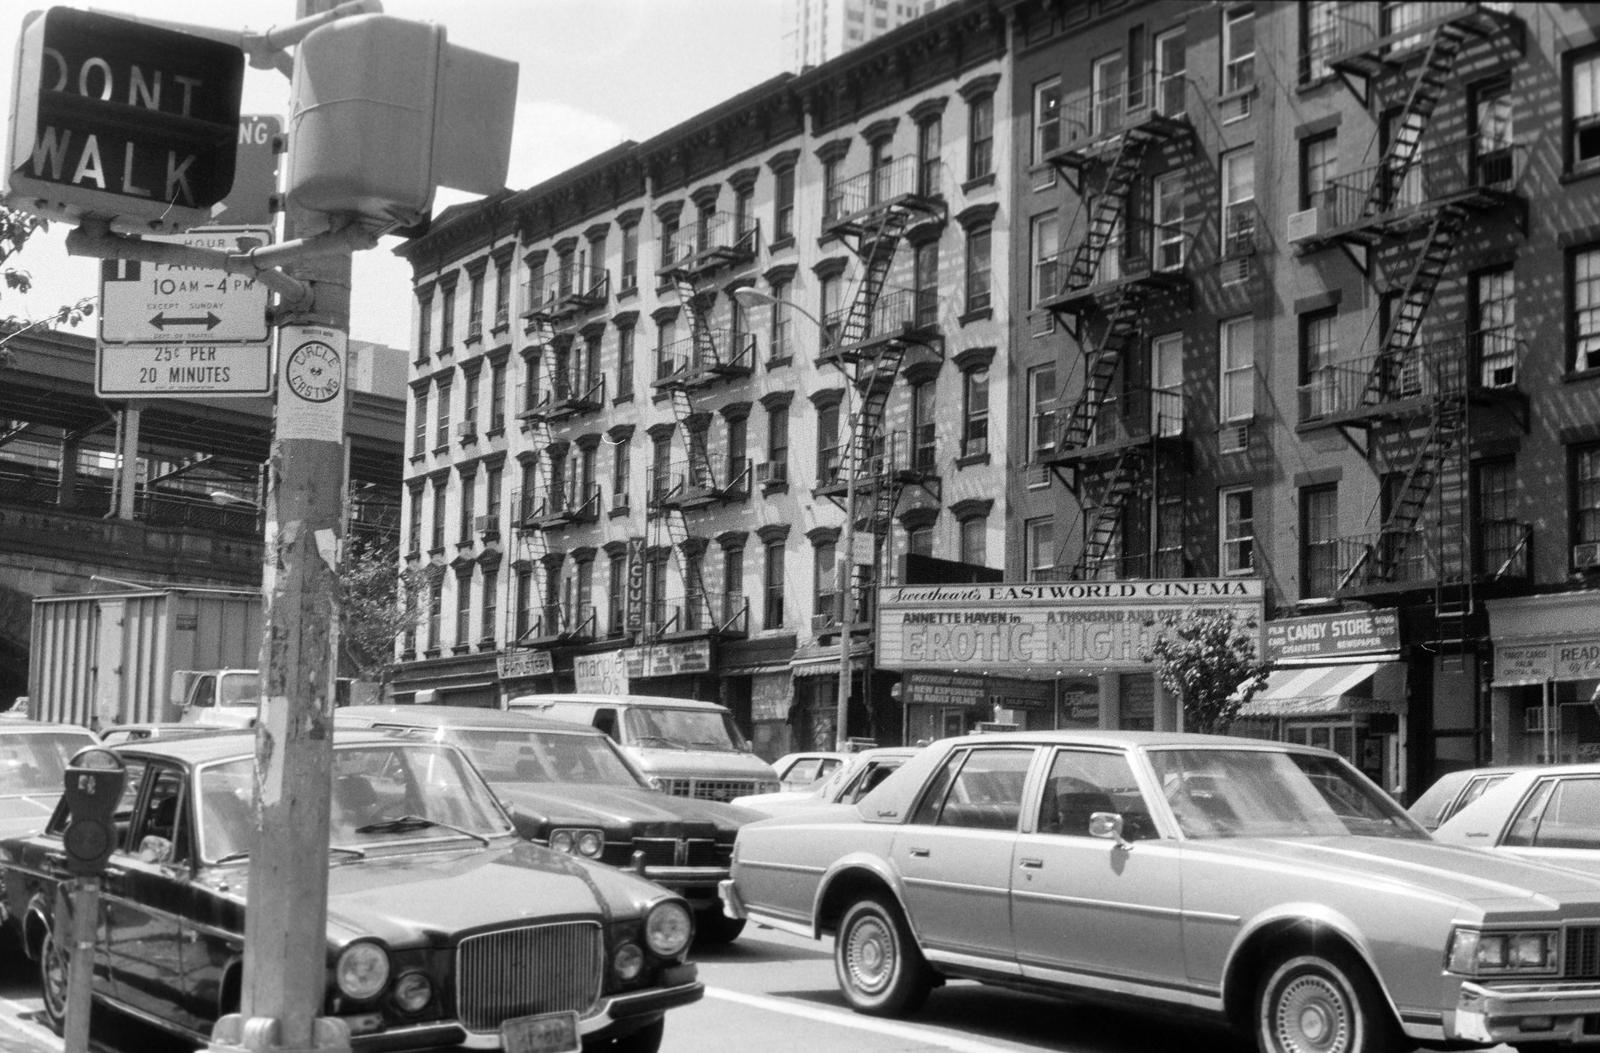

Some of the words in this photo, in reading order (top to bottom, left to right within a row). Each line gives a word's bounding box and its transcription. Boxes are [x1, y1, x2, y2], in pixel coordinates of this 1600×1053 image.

[44, 47, 203, 118] DONT
[32, 126, 199, 209] WALK
[184, 238, 226, 248] HOUR
[147, 302, 179, 310] EXCEPT
[189, 302, 224, 310] SUNDAY
[190, 346, 217, 361] PER
[294, 345, 338, 367] CIRCLE
[140, 367, 157, 383] 20
[169, 366, 231, 383] MINUTES
[630, 540, 643, 626] VACUUMS
[890, 588, 982, 602] Sweetheart's
[1146, 582, 1248, 597] CINEMA
[903, 612, 961, 624] ANNETTE
[964, 612, 1006, 624] HAVEN
[1009, 614, 1021, 624] in
[1047, 611, 1056, 622] A
[1058, 610, 1124, 622] THOUSAND
[1287, 622, 1327, 642] CANDY
[1331, 617, 1373, 637] STORE
[903, 623, 1034, 662] EROTIC
